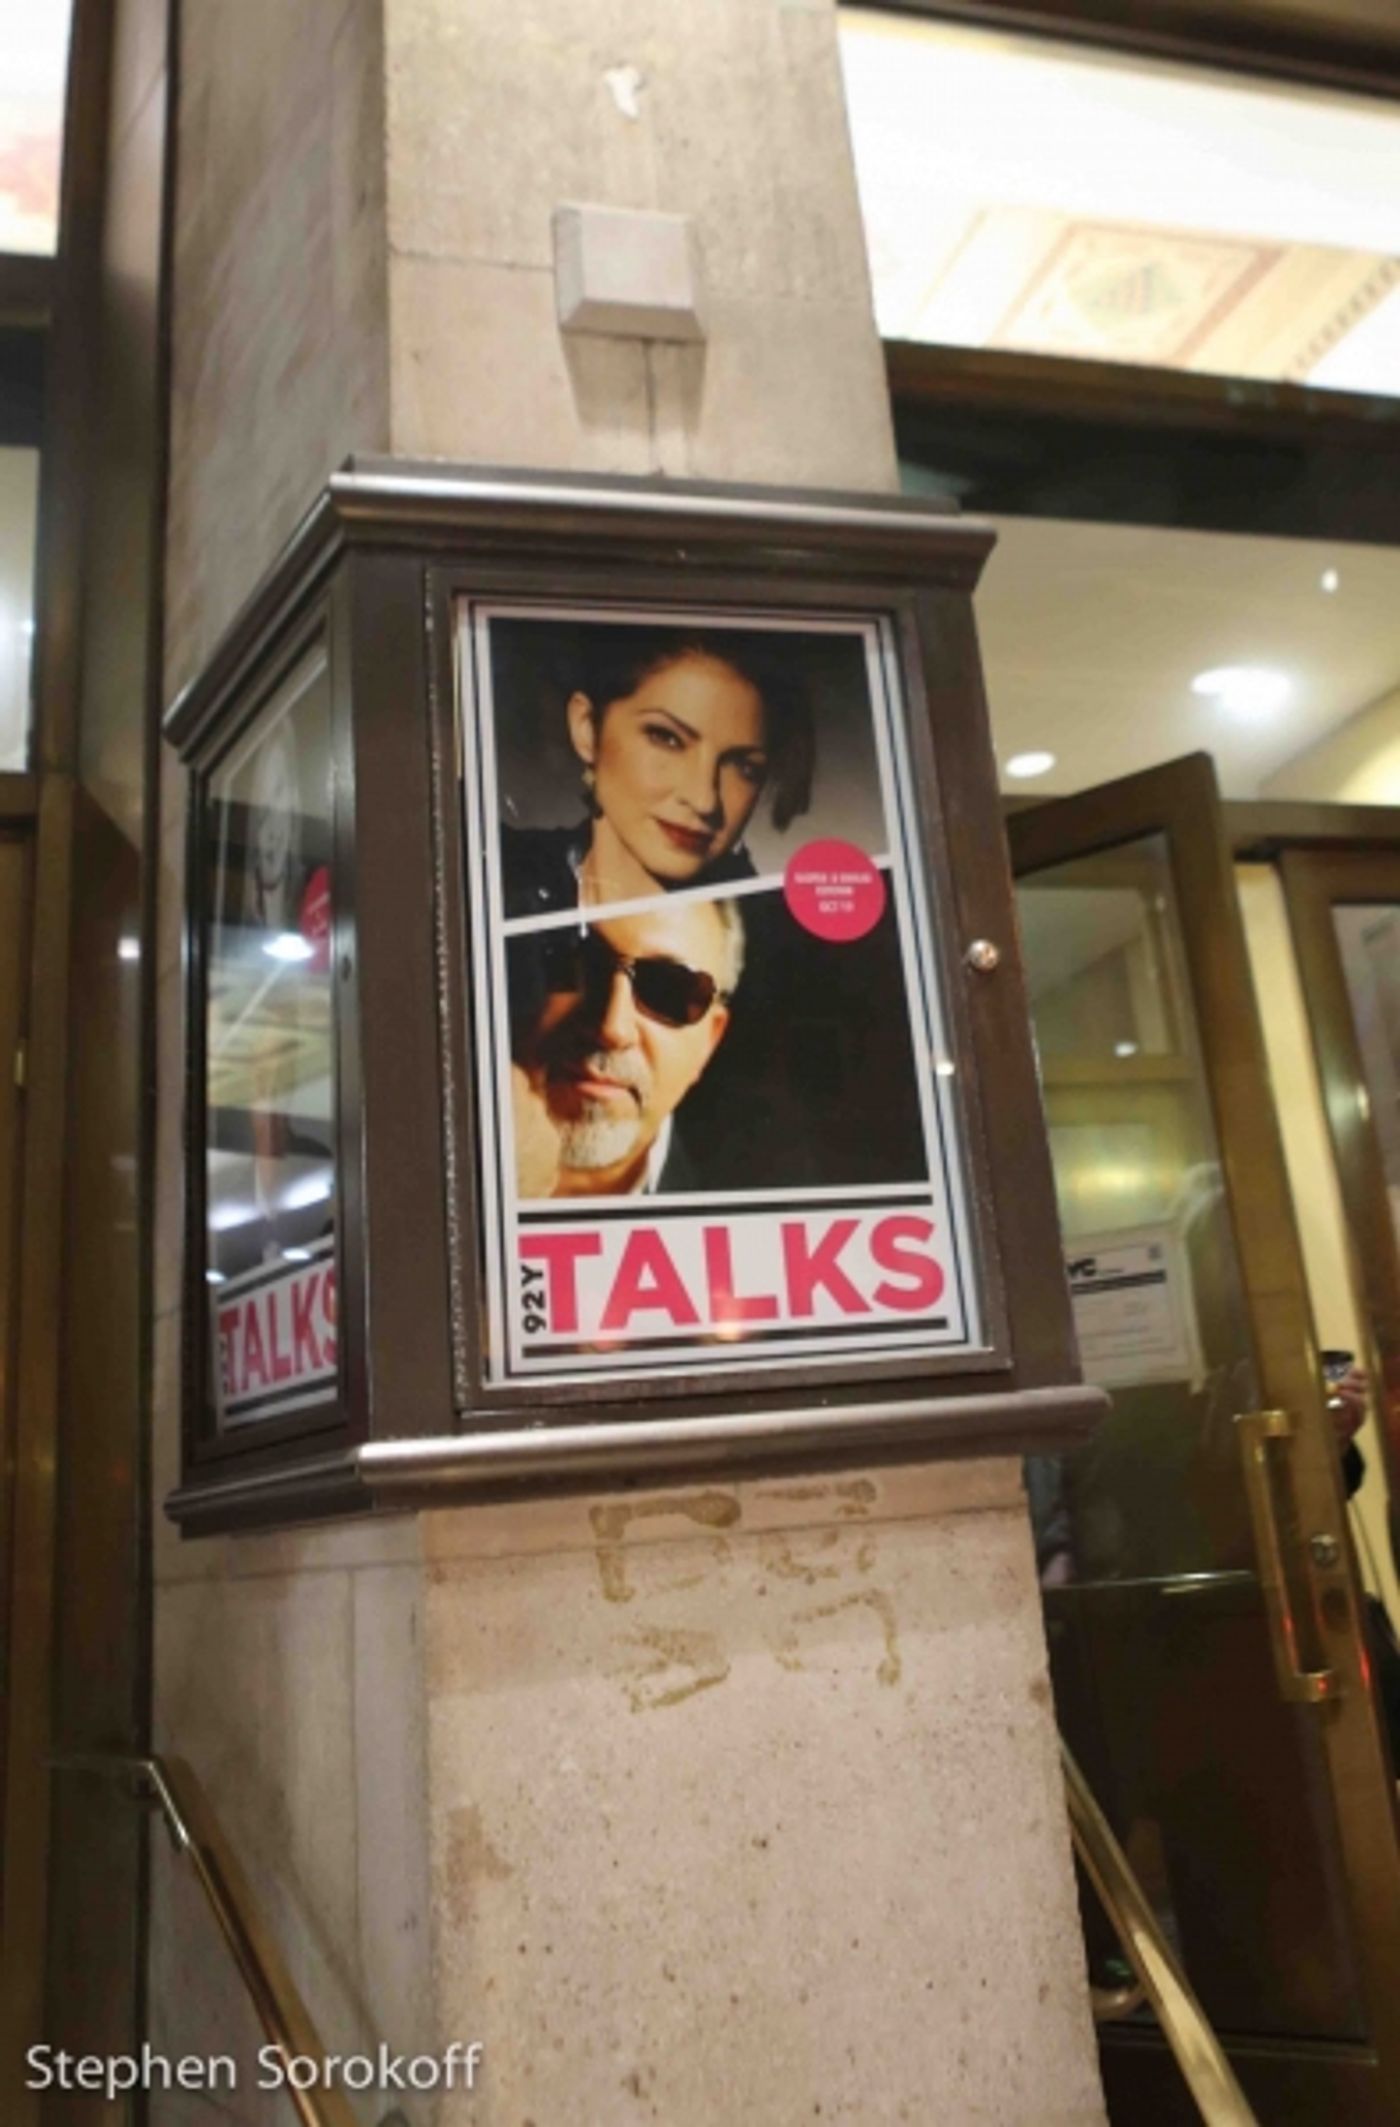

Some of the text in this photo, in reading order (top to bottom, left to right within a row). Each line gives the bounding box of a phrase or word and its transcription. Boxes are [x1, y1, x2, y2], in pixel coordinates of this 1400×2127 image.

[518, 1215, 945, 1334] TALKS
[521, 1264, 548, 1334] 92Y
[1067, 1257, 1096, 1277] YC
